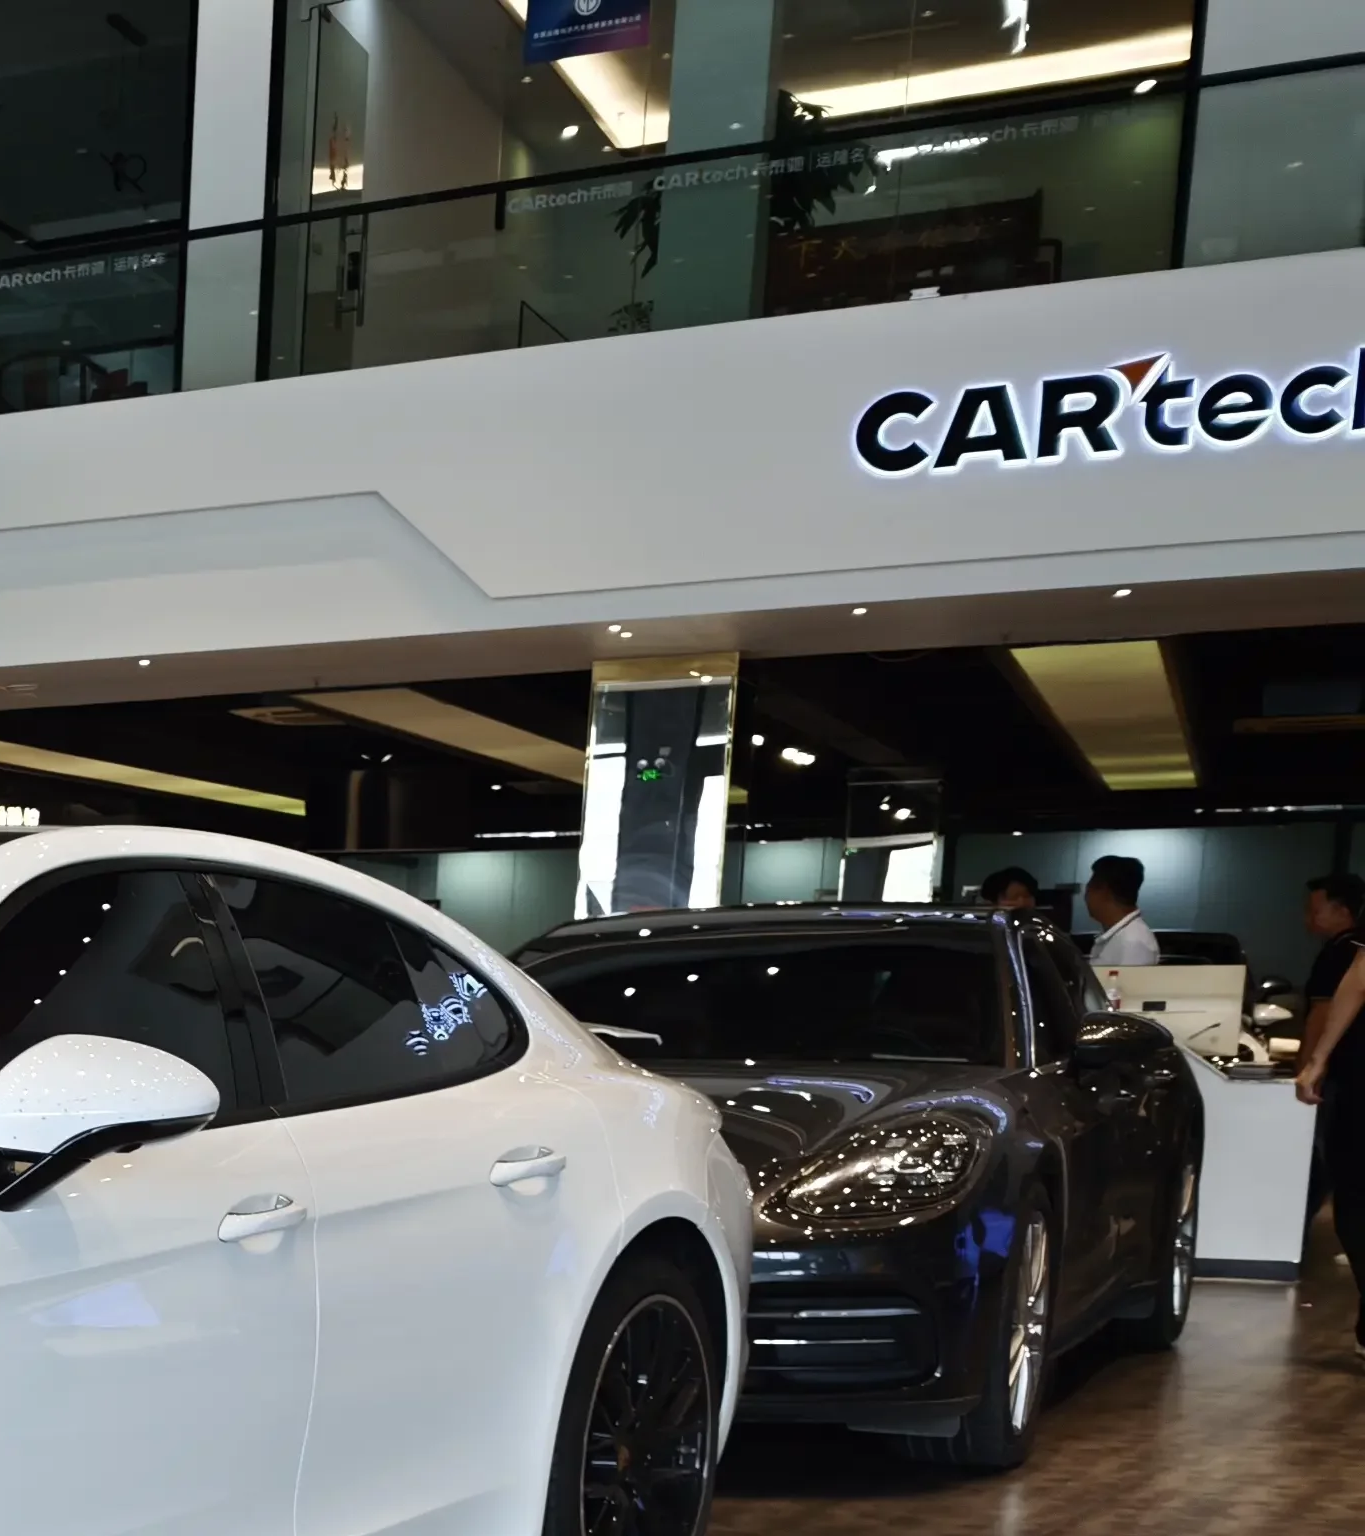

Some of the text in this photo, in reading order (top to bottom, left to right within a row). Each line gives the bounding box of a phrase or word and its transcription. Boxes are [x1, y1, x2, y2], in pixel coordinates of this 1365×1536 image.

[816, 144, 876, 169] 运隆名
[854, 347, 1365, 473] CARtec
